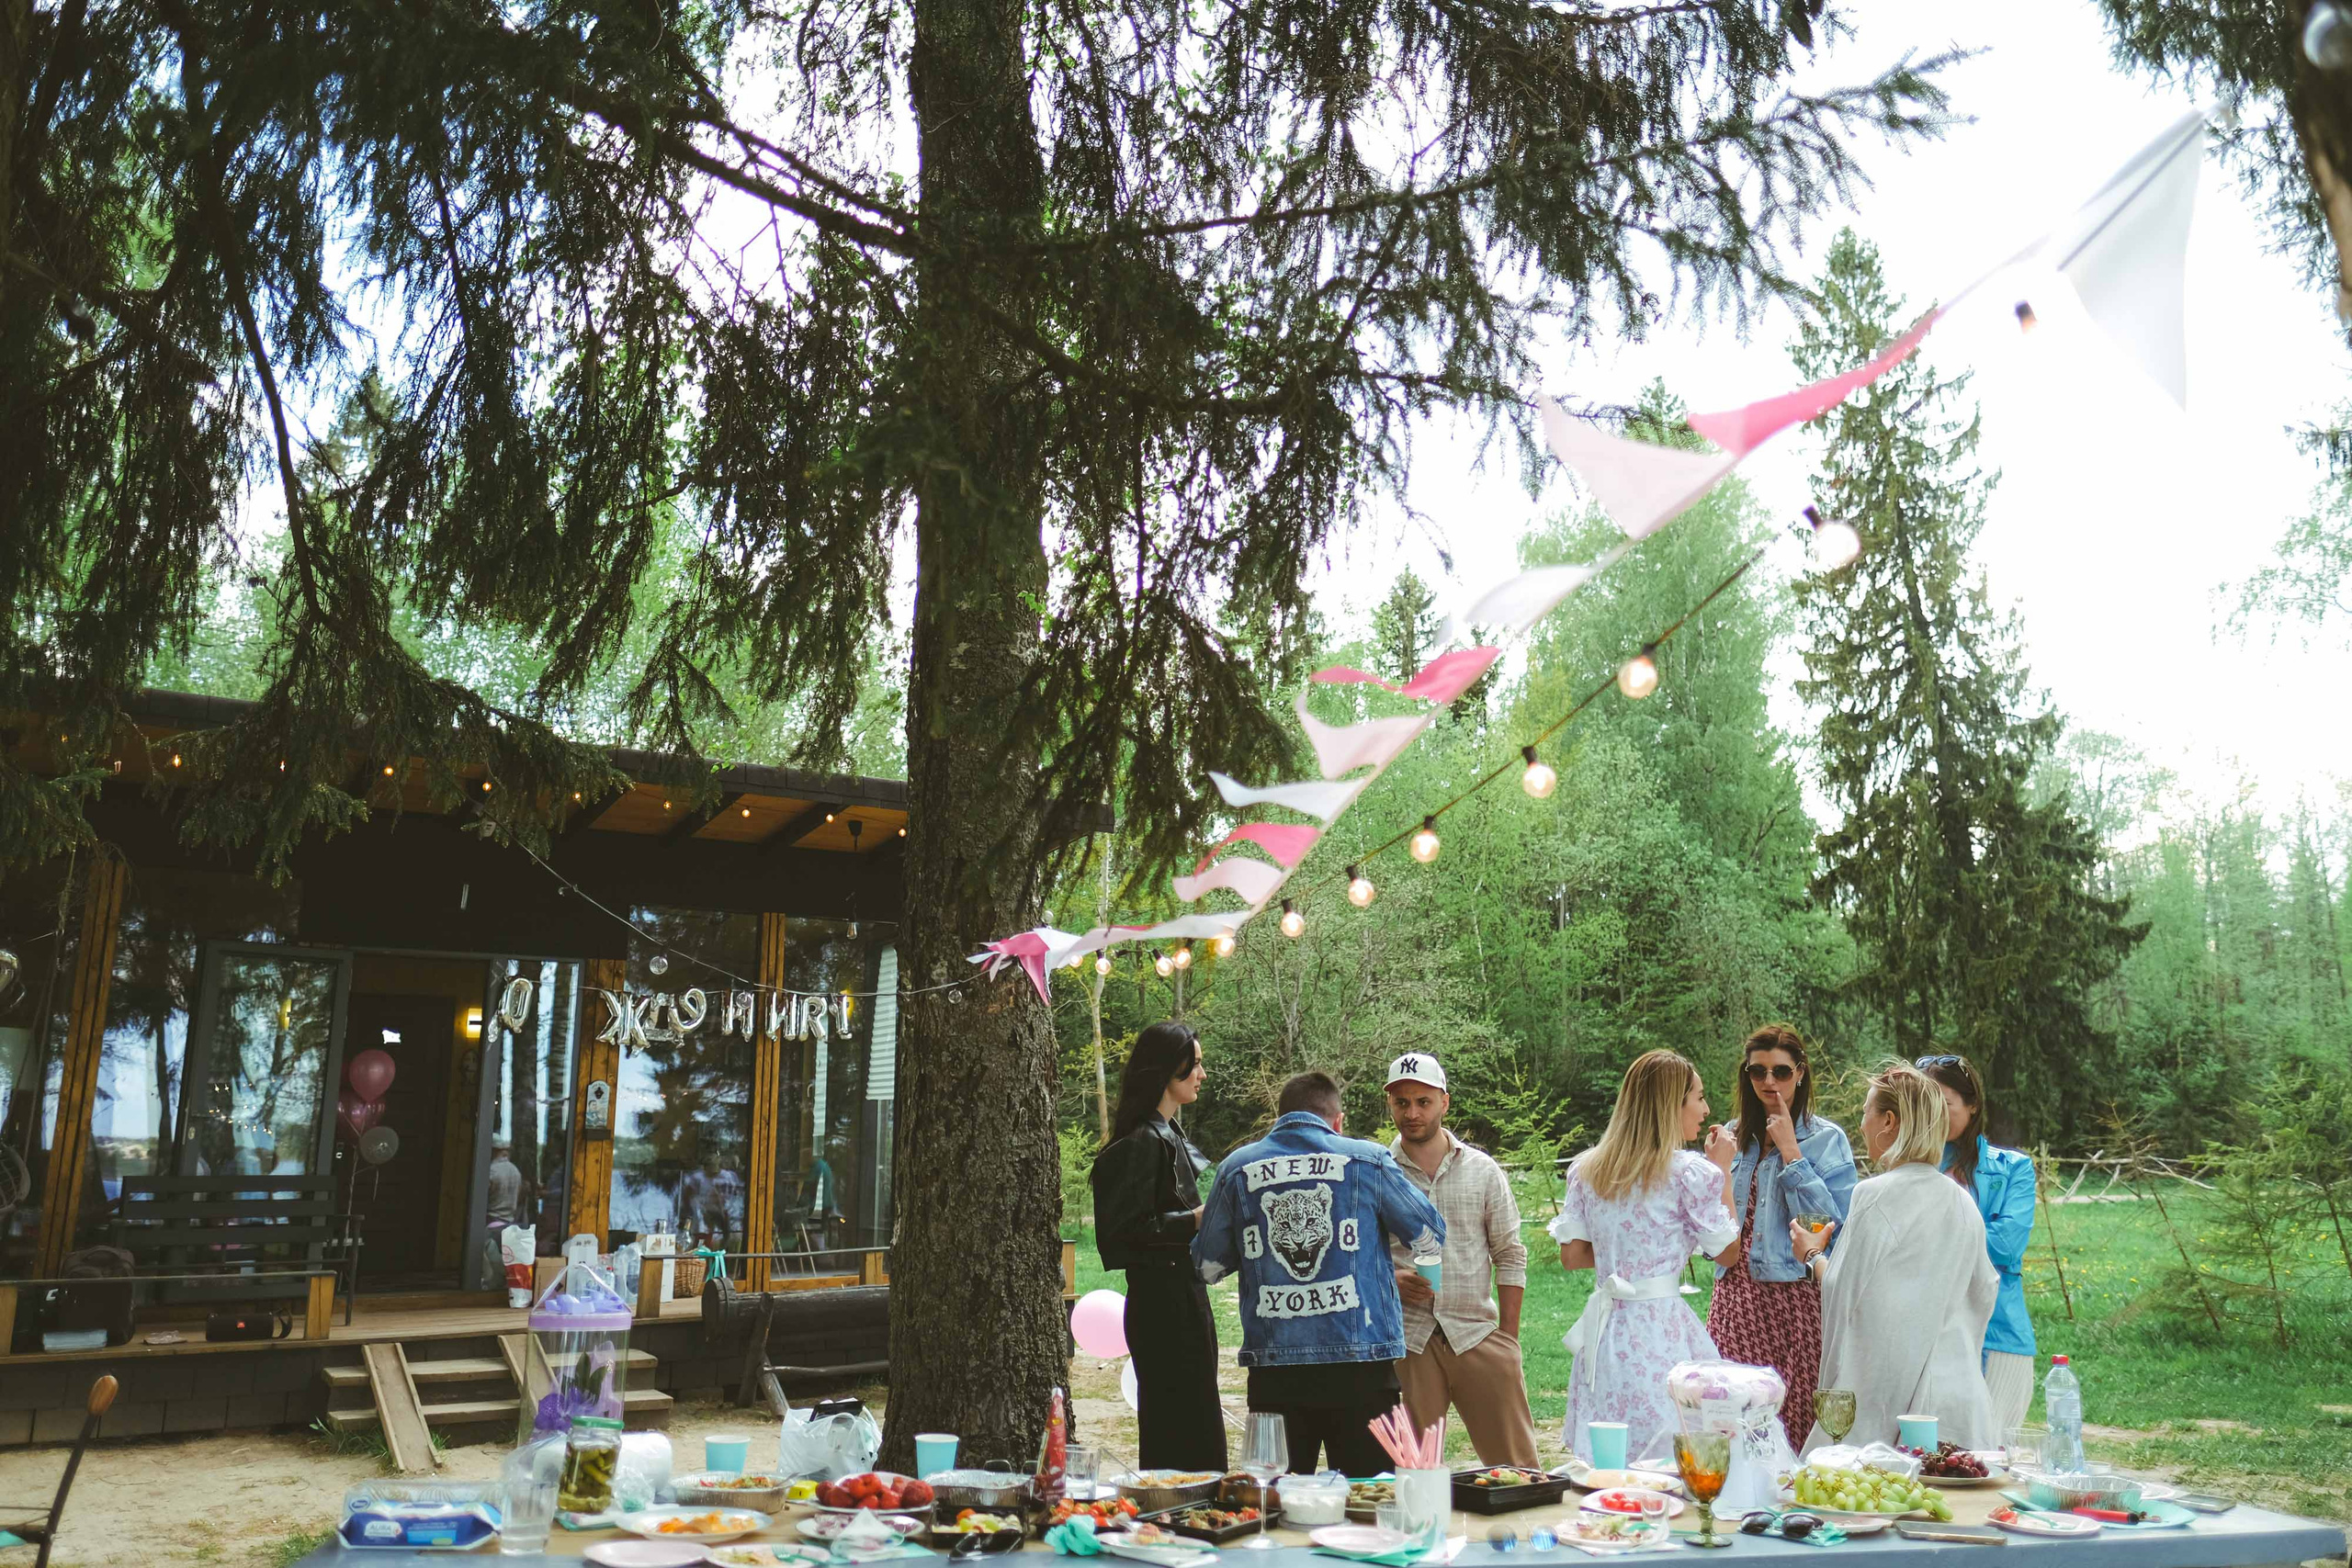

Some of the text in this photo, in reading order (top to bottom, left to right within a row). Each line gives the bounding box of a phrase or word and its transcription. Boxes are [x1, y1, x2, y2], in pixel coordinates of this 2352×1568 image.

[1400, 1057, 1419, 1075] NY
[1261, 1157, 1332, 1182] NEW
[1342, 1223, 1356, 1247] 8
[1267, 1284, 1347, 1312] YORK
